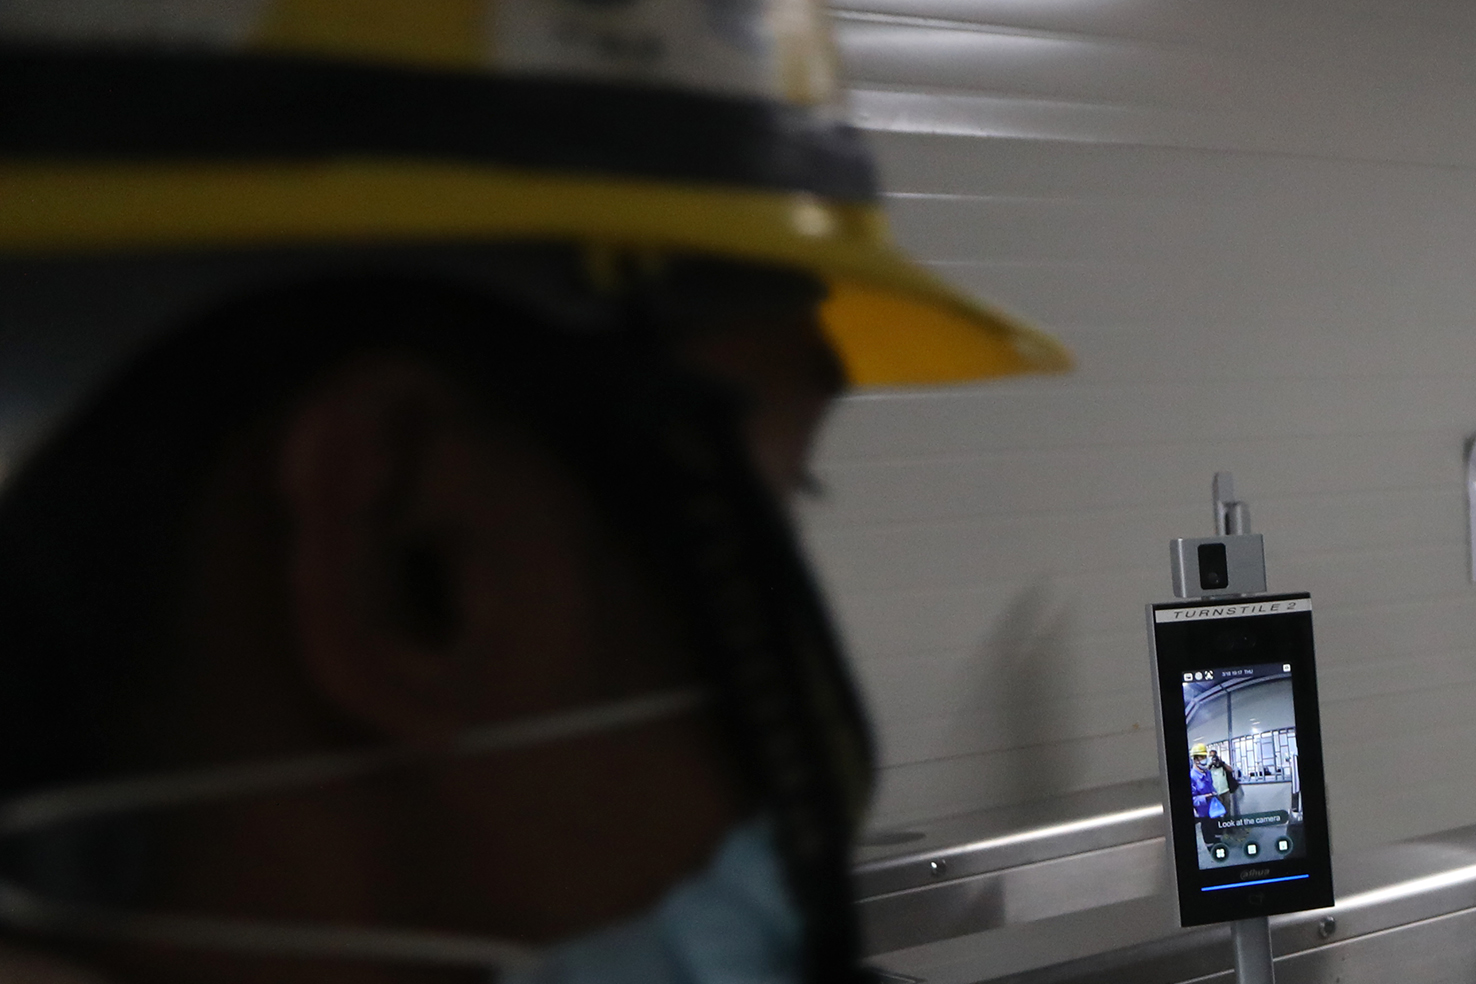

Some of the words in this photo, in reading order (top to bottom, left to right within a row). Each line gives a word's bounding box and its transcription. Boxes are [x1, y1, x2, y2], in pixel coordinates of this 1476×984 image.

[1174, 603, 1280, 619] TURNSTILE
[1286, 601, 1297, 611] 2
[1217, 820, 1236, 829] Look
[1235, 819, 1243, 827] at
[1243, 818, 1255, 826] the
[1255, 815, 1281, 824] camera
